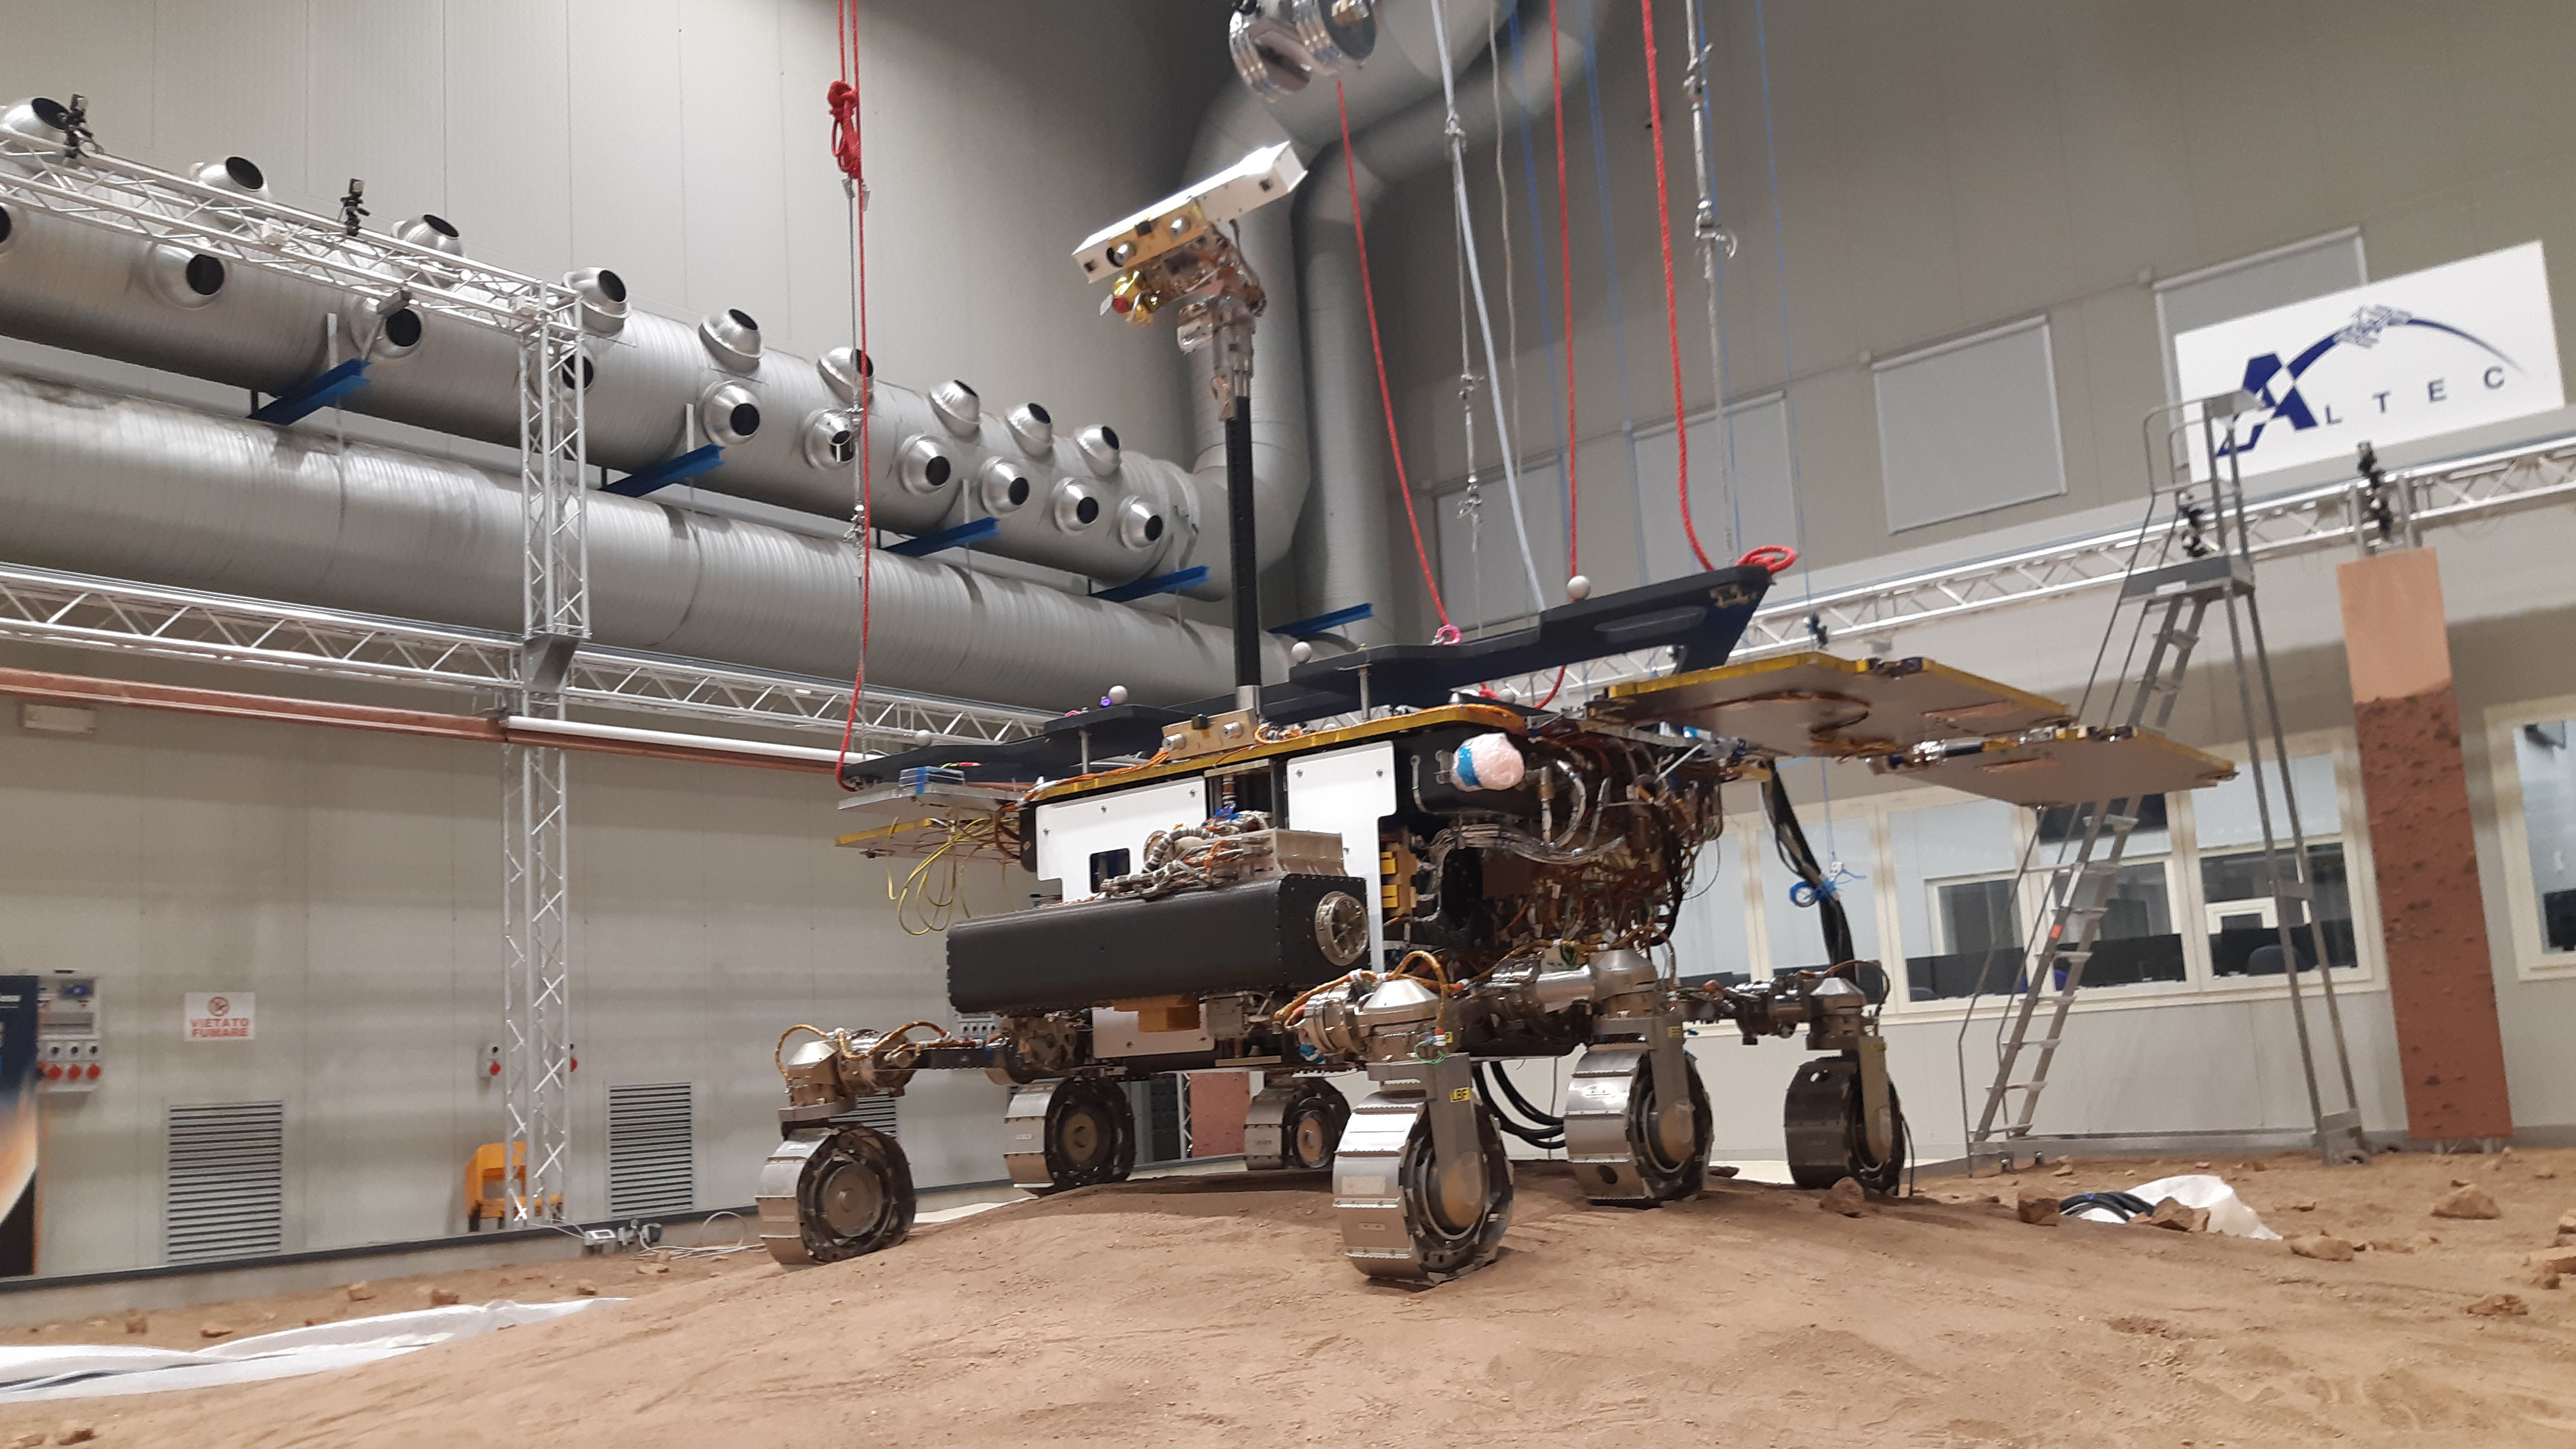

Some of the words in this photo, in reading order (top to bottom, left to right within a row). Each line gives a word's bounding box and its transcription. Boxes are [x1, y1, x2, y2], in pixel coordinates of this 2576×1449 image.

[2216, 352, 2505, 456] ALTEC
[190, 1017, 249, 1028] VIETATO
[192, 1028, 248, 1037] FUMARE
